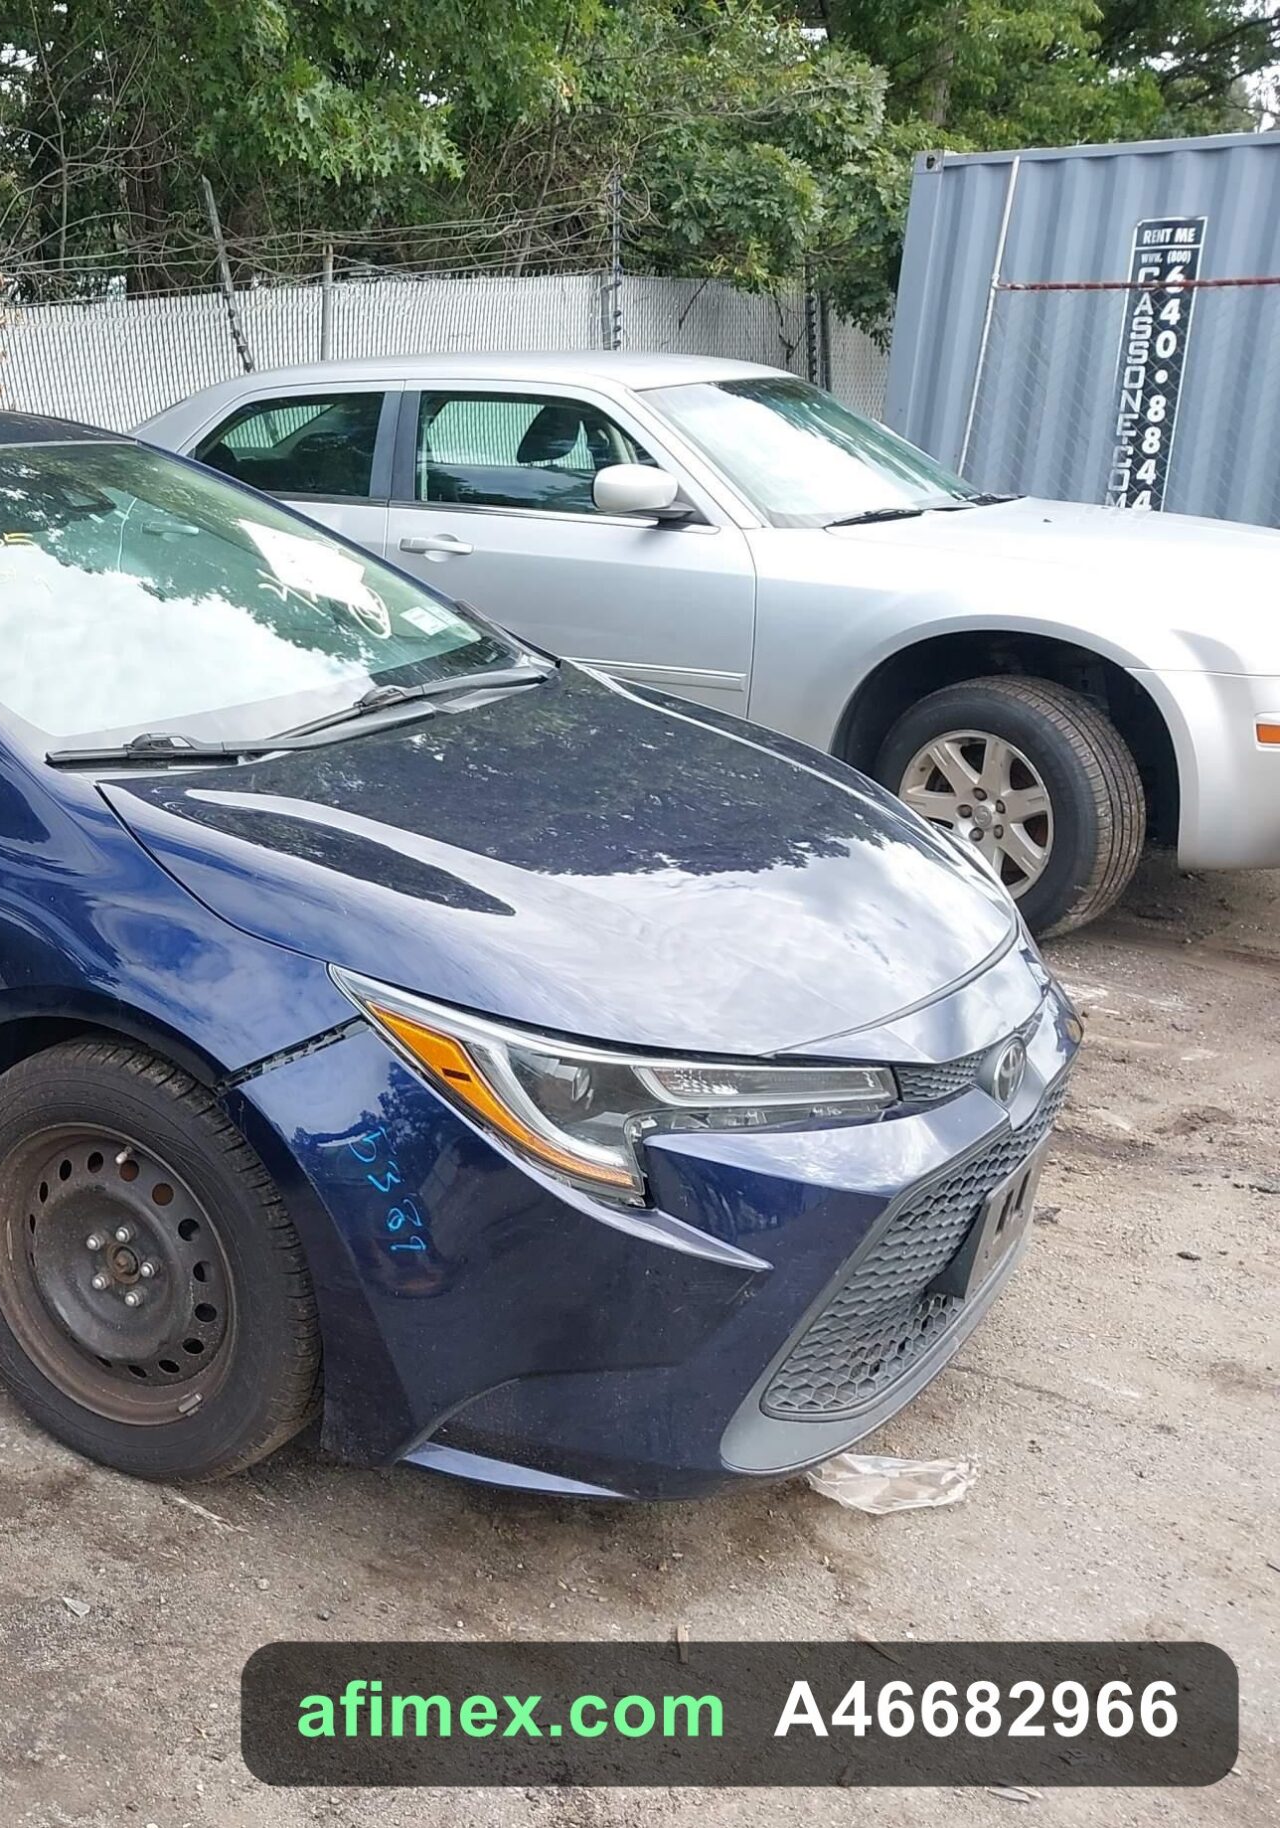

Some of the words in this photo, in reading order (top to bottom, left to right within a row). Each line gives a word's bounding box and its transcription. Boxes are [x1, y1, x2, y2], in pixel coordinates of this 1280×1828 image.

[1143, 228, 1173, 244] RENT
[1174, 227, 1196, 243] ME
[1167, 250, 1192, 264] (800)
